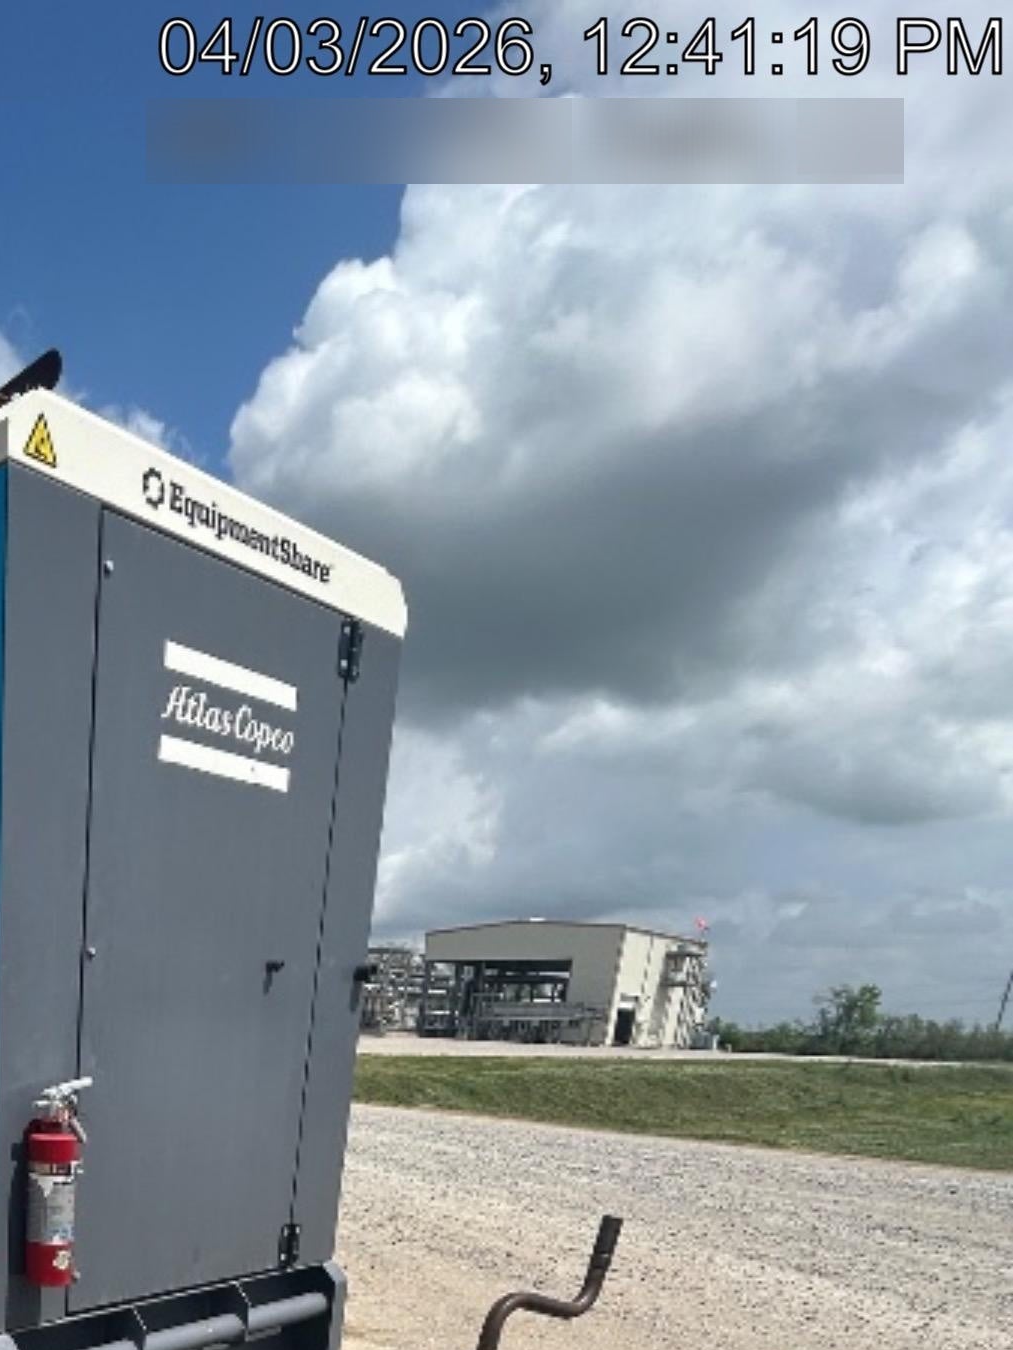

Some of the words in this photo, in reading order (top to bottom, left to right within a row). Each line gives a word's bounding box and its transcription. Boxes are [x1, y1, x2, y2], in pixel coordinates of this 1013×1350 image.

[169, 480, 331, 583] EquipmentShare
[161, 686, 233, 736] Atlas
[235, 705, 294, 754] Copco
